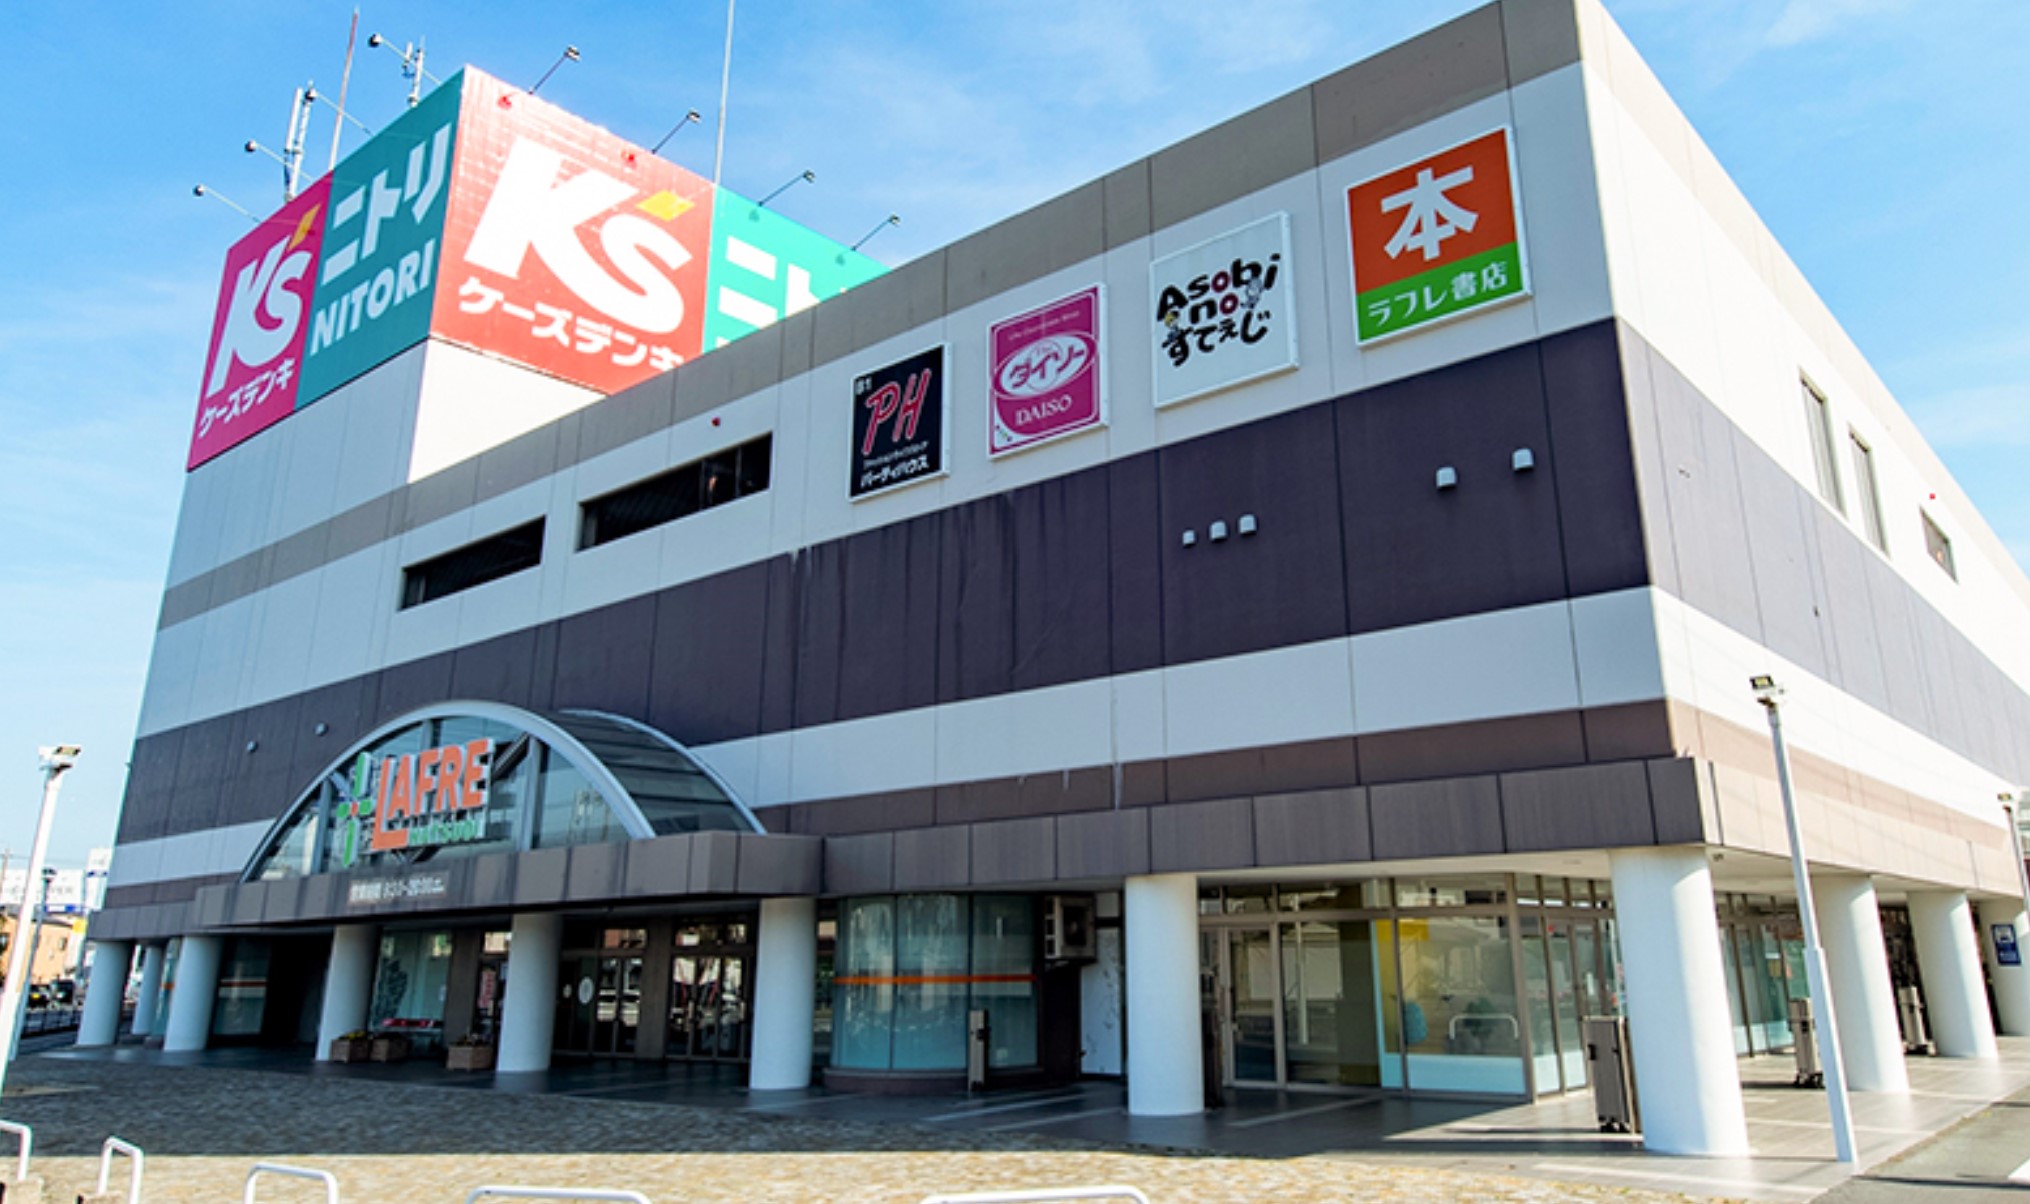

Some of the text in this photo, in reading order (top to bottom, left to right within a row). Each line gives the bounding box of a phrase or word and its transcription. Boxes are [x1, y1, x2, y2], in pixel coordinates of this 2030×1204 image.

[322, 121, 452, 287] ニトリ
[1382, 166, 1479, 262] 本
[309, 237, 436, 356] NITORI
[458, 275, 685, 373] ケーズデンキ
[1156, 252, 1281, 322] Asobi
[1189, 292, 1239, 324] no
[1367, 260, 1508, 327] ラフレ書店
[199, 357, 296, 439] ケーズデンキ
[1009, 343, 1086, 390] ダイソー
[861, 367, 933, 456] PH
[1015, 393, 1073, 427] DAISO
[371, 738, 493, 850] LAFRE
